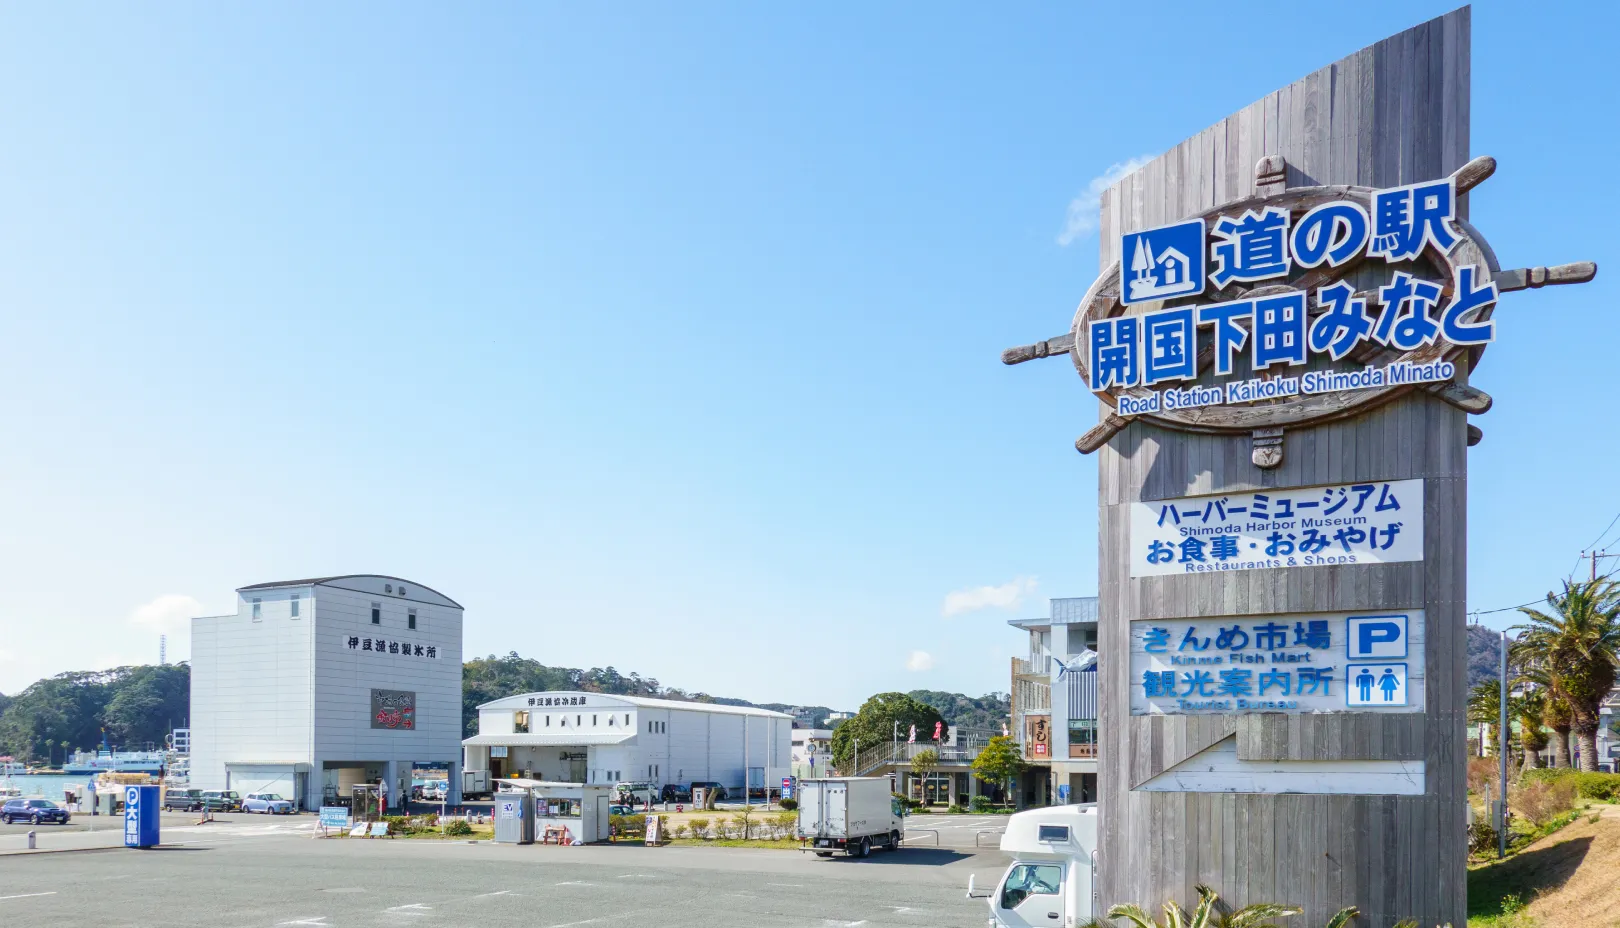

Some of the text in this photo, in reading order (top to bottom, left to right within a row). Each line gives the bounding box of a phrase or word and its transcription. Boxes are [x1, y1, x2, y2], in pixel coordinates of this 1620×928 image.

[1210, 179, 1461, 289] 道の駅
[1091, 266, 1497, 390] 開国下田みなと
[1119, 361, 1453, 415] Road Station Kaikoku Shimoda Minato
[1157, 484, 1401, 526] ハーバーミュージアム
[1179, 514, 1367, 537] Shimoda Harbor Museum
[1146, 521, 1403, 564] お食事・おみやげ
[1186, 553, 1357, 572] Restaurants & Shops
[1143, 620, 1332, 653] きんめ市場
[1358, 622, 1401, 654] P
[1171, 651, 1311, 665] Kinme Fish Mart
[1142, 666, 1334, 698] 観光案内所
[1176, 699, 1297, 710] Tourist Bureau
[1036, 720, 1046, 741] すし
